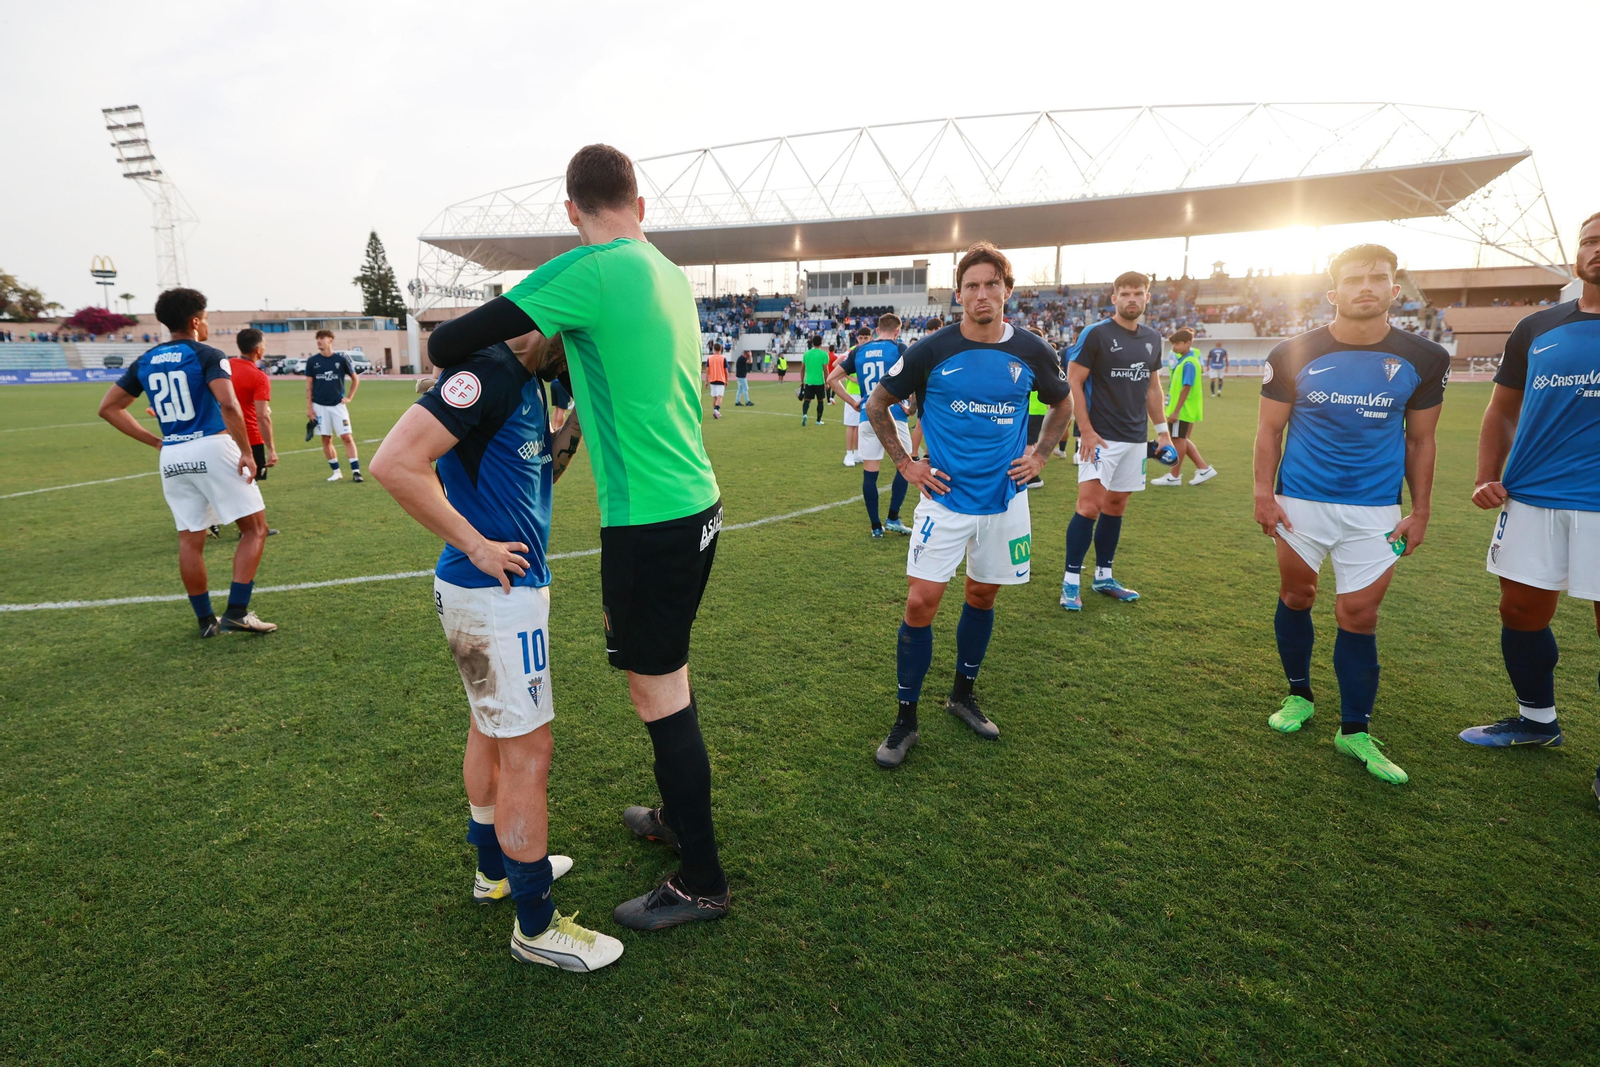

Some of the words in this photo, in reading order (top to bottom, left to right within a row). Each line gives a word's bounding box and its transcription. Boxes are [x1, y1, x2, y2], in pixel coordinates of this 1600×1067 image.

[862, 361, 885, 396] 21
[1550, 369, 1600, 387] CRISTALV
[148, 370, 196, 423] 20
[1582, 389, 1600, 398] REH
[1363, 410, 1389, 419] REHAU
[920, 515, 935, 544] 4
[1497, 511, 1508, 540] 9
[517, 628, 546, 675] 10
